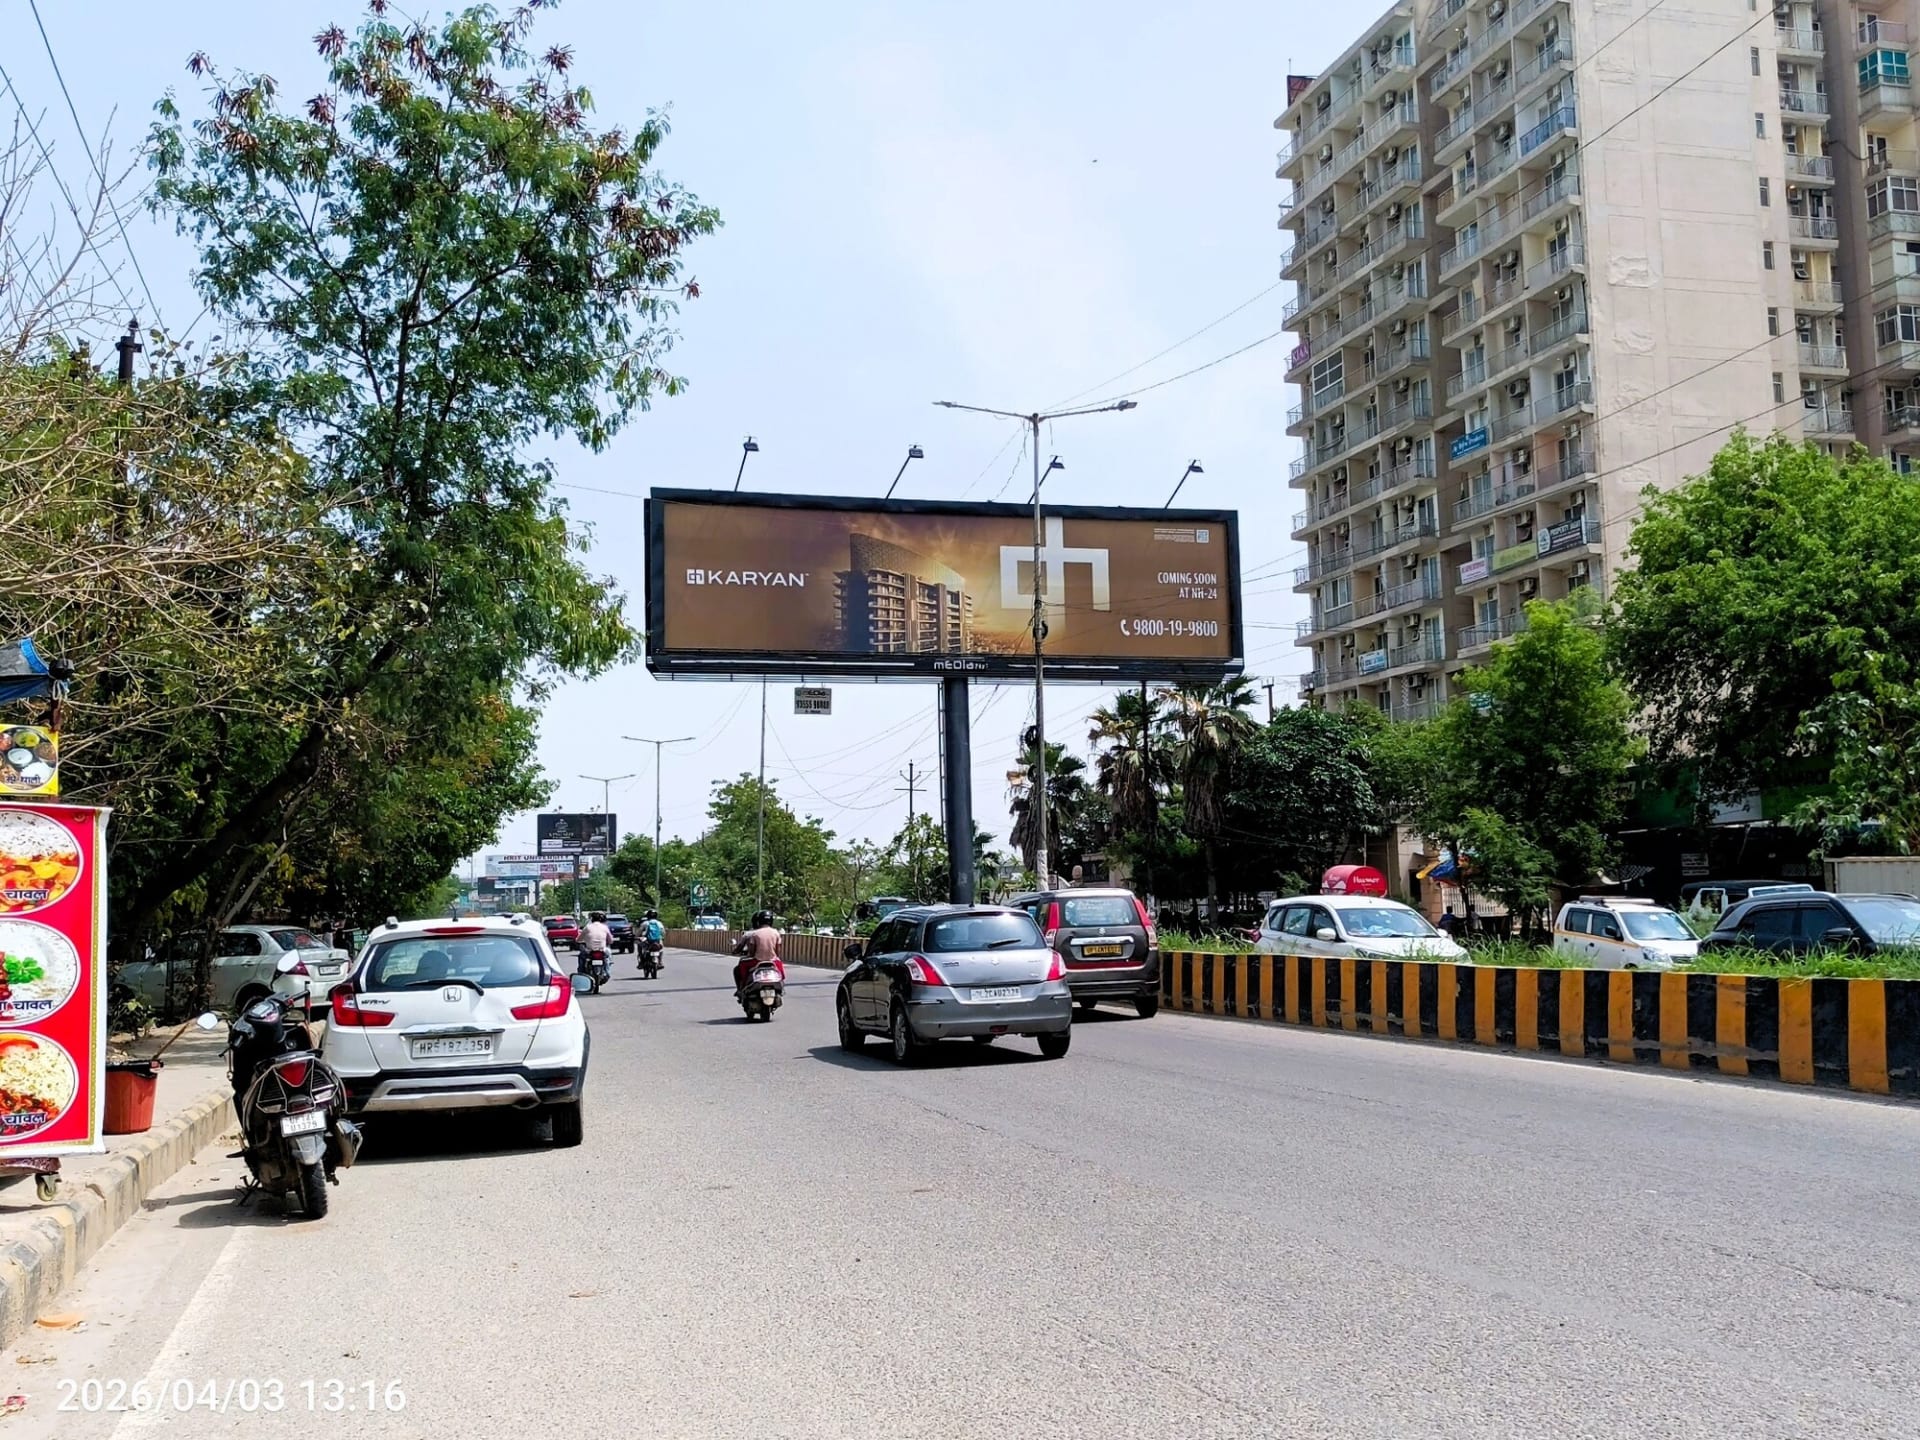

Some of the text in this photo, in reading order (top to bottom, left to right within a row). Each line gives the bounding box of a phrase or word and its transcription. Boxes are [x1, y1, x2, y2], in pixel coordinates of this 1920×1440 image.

[707, 569, 805, 588] KARYAN
[1157, 572, 1217, 585] COMING SOON
[1178, 588, 1217, 600] AT NH-24
[1133, 618, 1218, 637] 9800-19-9800
[4, 889, 49, 899] चावल
[12, 999, 53, 1010] चावल
[4, 1112, 46, 1124] चावल
